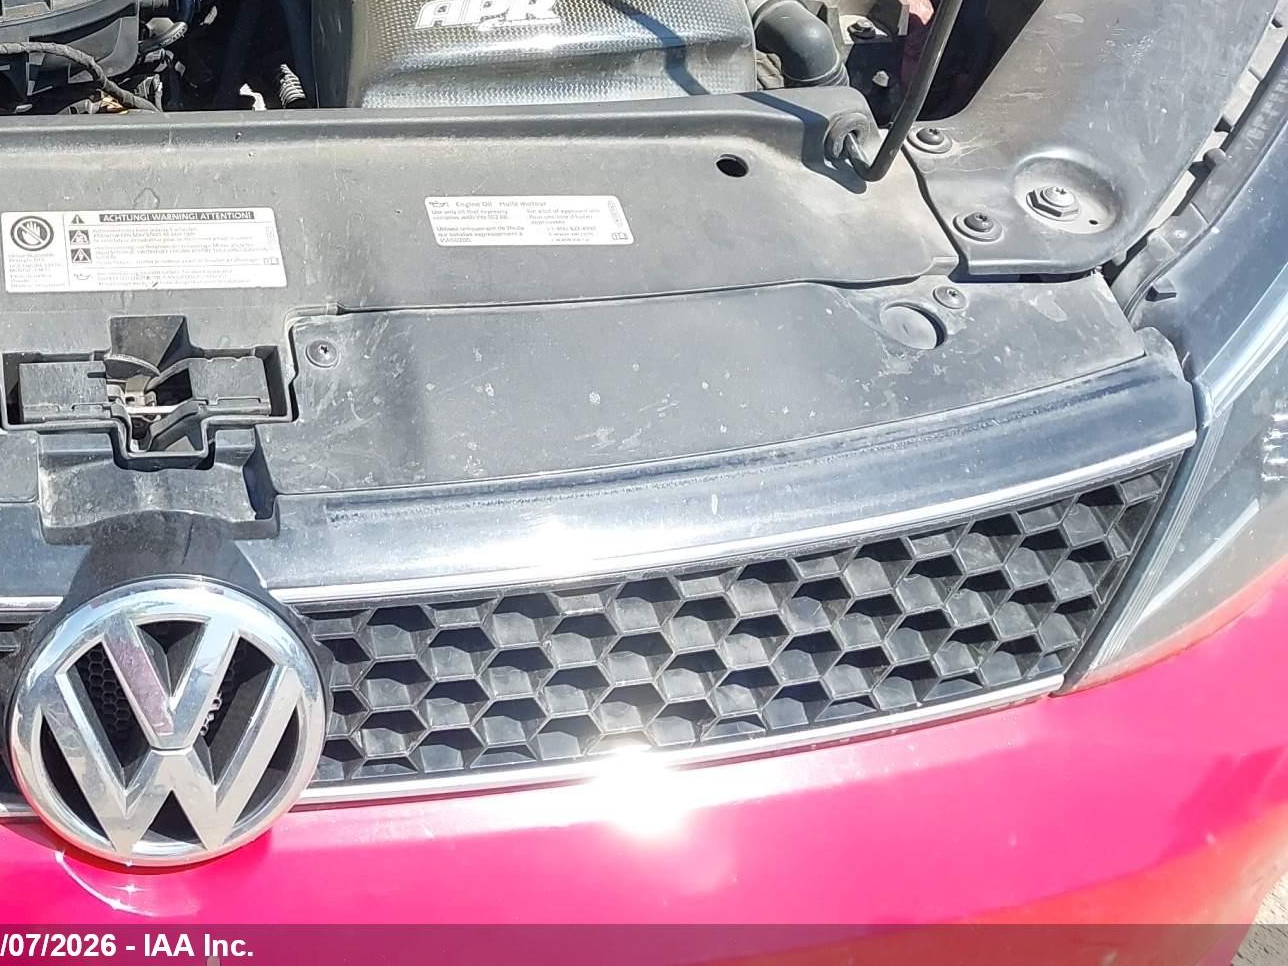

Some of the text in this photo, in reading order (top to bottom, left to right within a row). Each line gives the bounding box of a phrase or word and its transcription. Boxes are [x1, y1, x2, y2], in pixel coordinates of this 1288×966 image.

[103, 211, 251, 222] ACHTUNG! WARNING! ATTENTION!
[10, 576, 325, 866] VW
